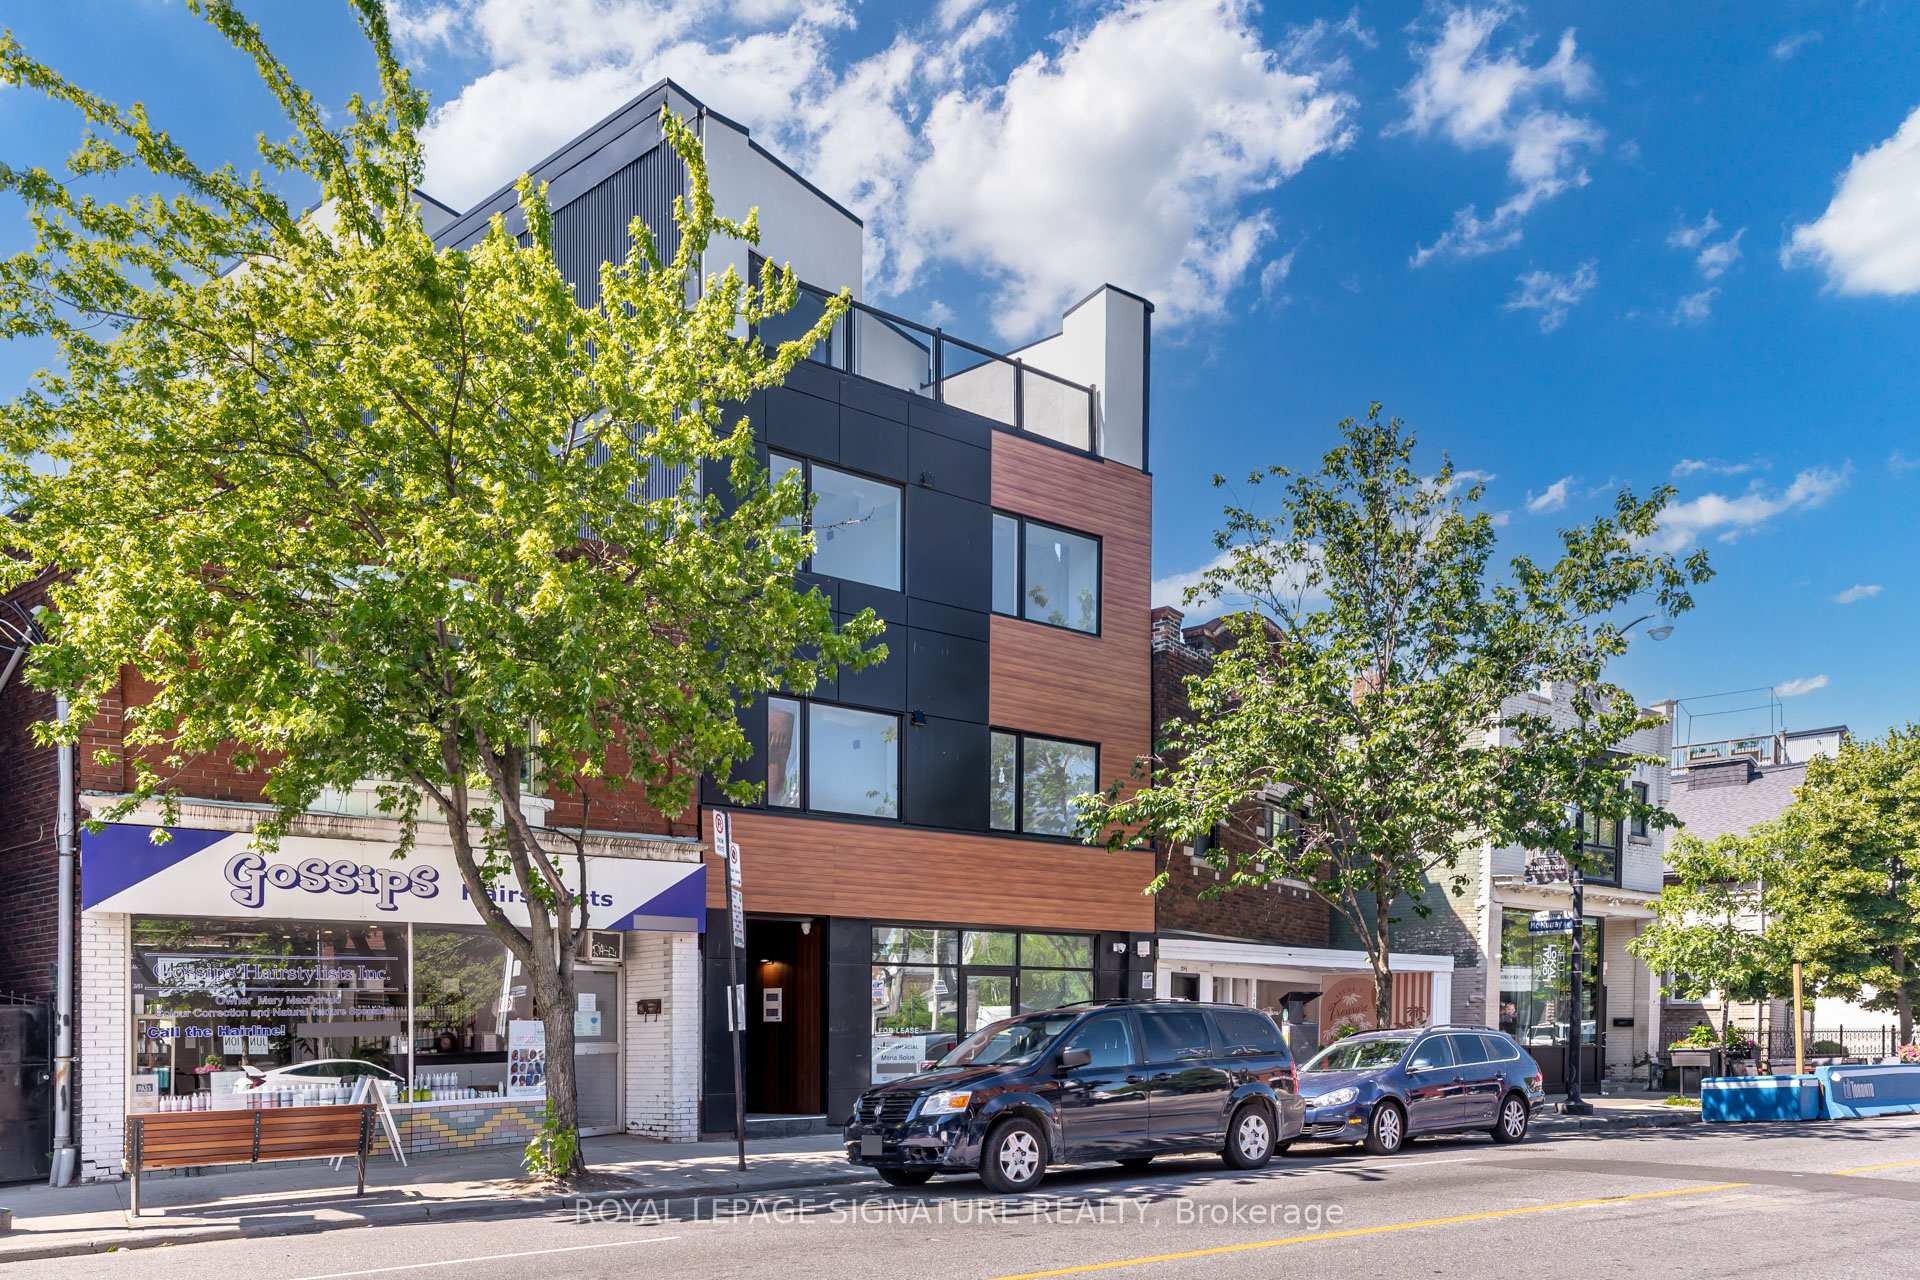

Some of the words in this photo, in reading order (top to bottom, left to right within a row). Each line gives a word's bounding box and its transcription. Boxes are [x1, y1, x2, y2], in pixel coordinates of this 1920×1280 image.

[224, 852, 439, 911] Gossips
[153, 962, 237, 982] Gossips
[241, 963, 354, 986] Hairstylists
[357, 964, 391, 981] Inc.
[215, 996, 253, 1006] Owner
[258, 996, 284, 1006] Mary
[286, 995, 342, 1005] MacDonald
[193, 1008, 249, 1018] Correction
[272, 1008, 309, 1017] Natural
[147, 1026, 181, 1038] Call
[185, 1025, 213, 1037] the
[217, 1024, 286, 1038] Hairline!
